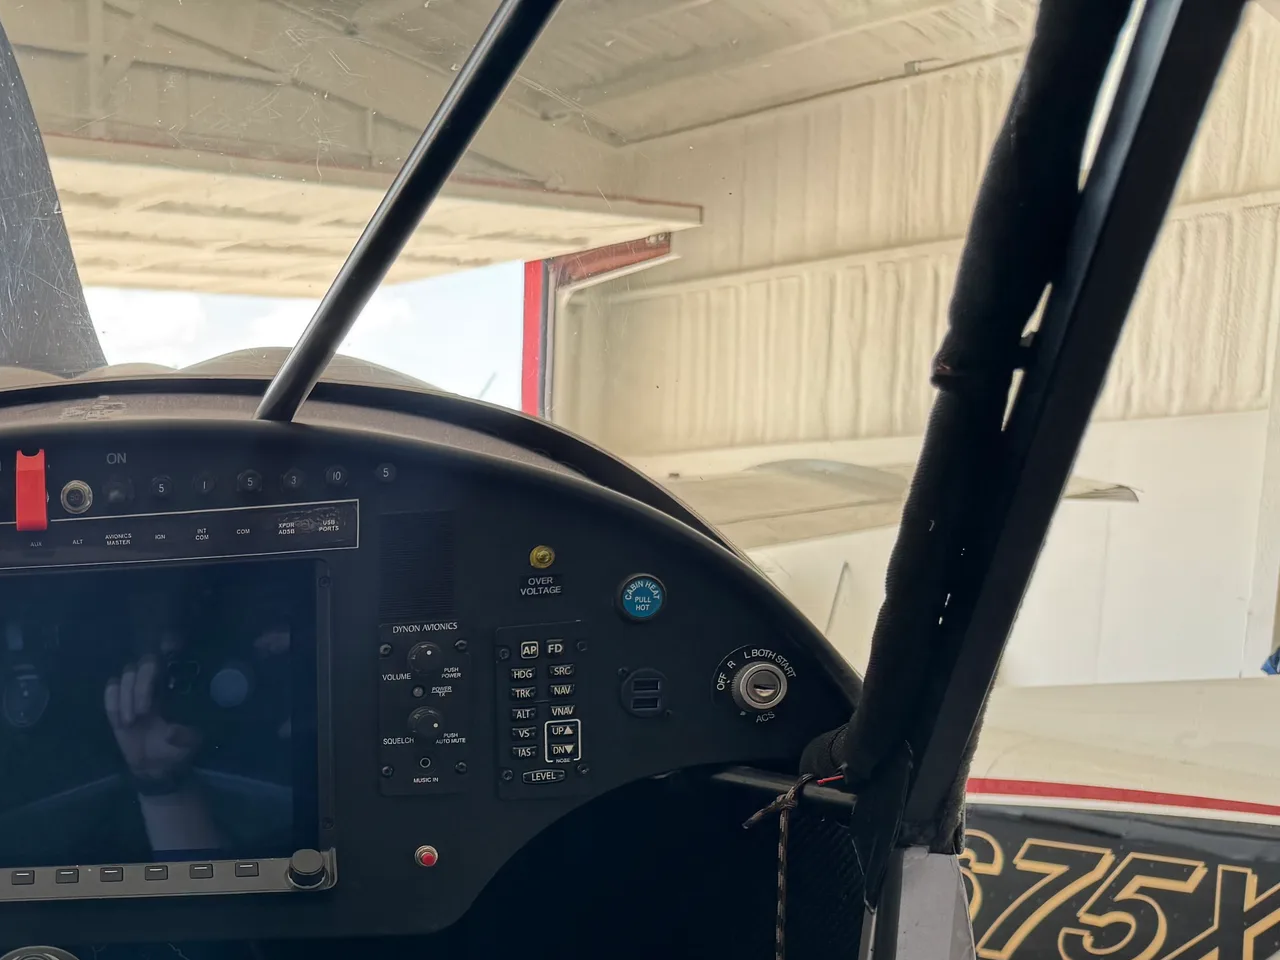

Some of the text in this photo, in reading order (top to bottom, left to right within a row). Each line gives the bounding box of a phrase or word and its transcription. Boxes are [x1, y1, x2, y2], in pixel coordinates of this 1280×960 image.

[107, 453, 126, 464] ON
[333, 472, 341, 480] 10
[383, 468, 389, 477] 5
[247, 478, 253, 486] 5
[291, 476, 297, 485] 3
[158, 484, 164, 492] 5
[528, 577, 553, 586] OVER
[521, 586, 561, 595] VOLTAGE
[625, 581, 660, 600] CABIN HEAT
[393, 622, 457, 633] DYNON AVIONICS
[523, 646, 536, 654] AP
[548, 644, 562, 653] FD
[752, 649, 776, 659] BOTH
[727, 660, 736, 668] R
[776, 656, 796, 678] START
[514, 670, 532, 679] HDG
[554, 667, 571, 676] SRC
[717, 672, 726, 690] OFF
[516, 690, 530, 698] TRK
[554, 687, 570, 695] NAV
[517, 710, 530, 718] ALT
[552, 707, 573, 716] VNAV
[756, 712, 775, 722] ACS
[519, 729, 529, 738] VS
[552, 727, 564, 735] UP
[518, 749, 531, 757] IAS
[553, 746, 564, 754] DN
[531, 772, 556, 781] LEVEL
